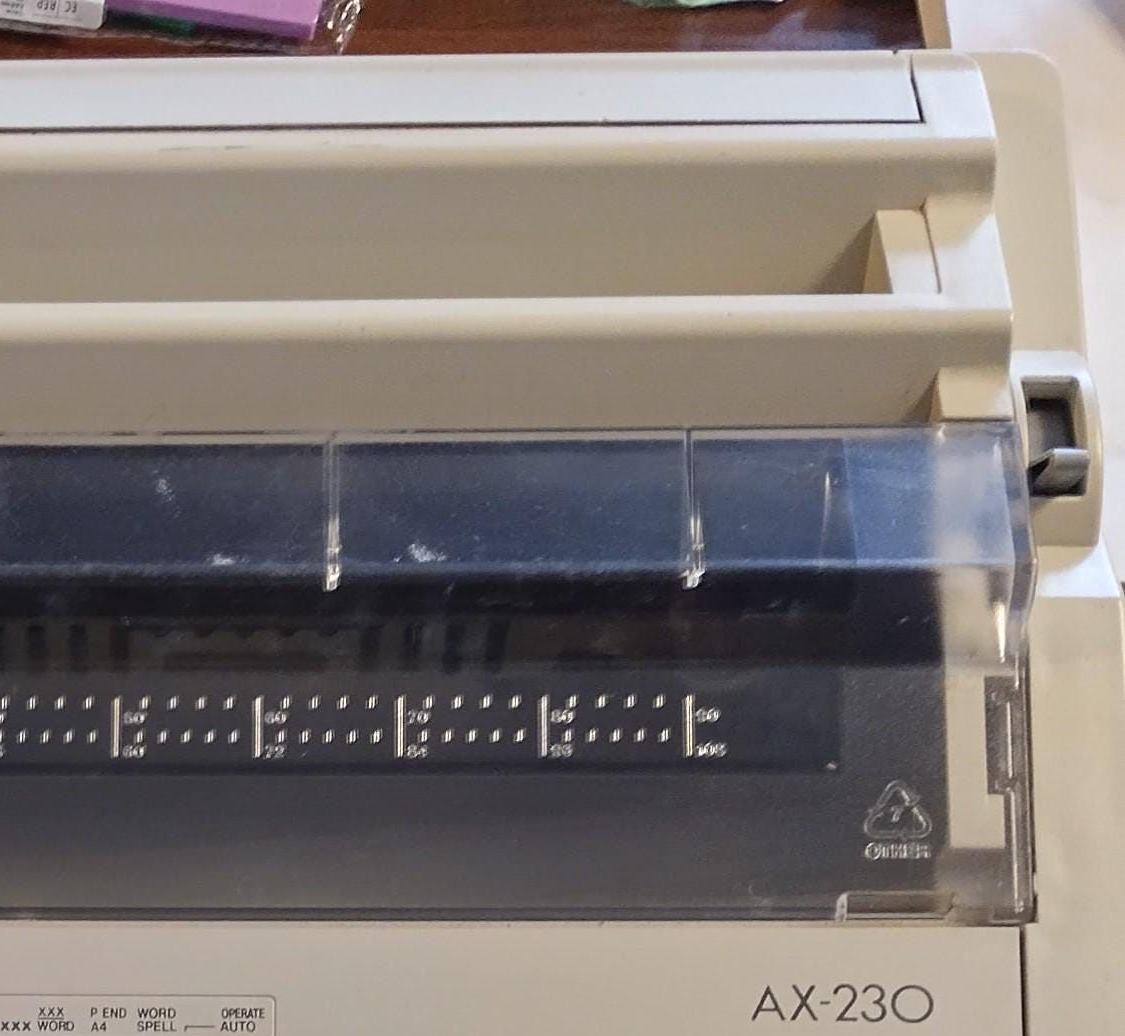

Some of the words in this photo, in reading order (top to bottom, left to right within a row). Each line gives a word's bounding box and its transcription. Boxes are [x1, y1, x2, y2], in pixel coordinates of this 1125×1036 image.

[752, 984, 933, 1023] AX-230
[38, 1007, 65, 1018] XXX
[91, 1008, 97, 1017] P
[103, 1008, 126, 1018] END
[137, 1008, 176, 1019] WORD
[220, 1008, 265, 1020] OPERATE
[37, 1021, 74, 1032] WORD
[91, 1022, 106, 1031] A4
[137, 1021, 177, 1033] SPELL
[220, 1021, 256, 1033] AUTO
